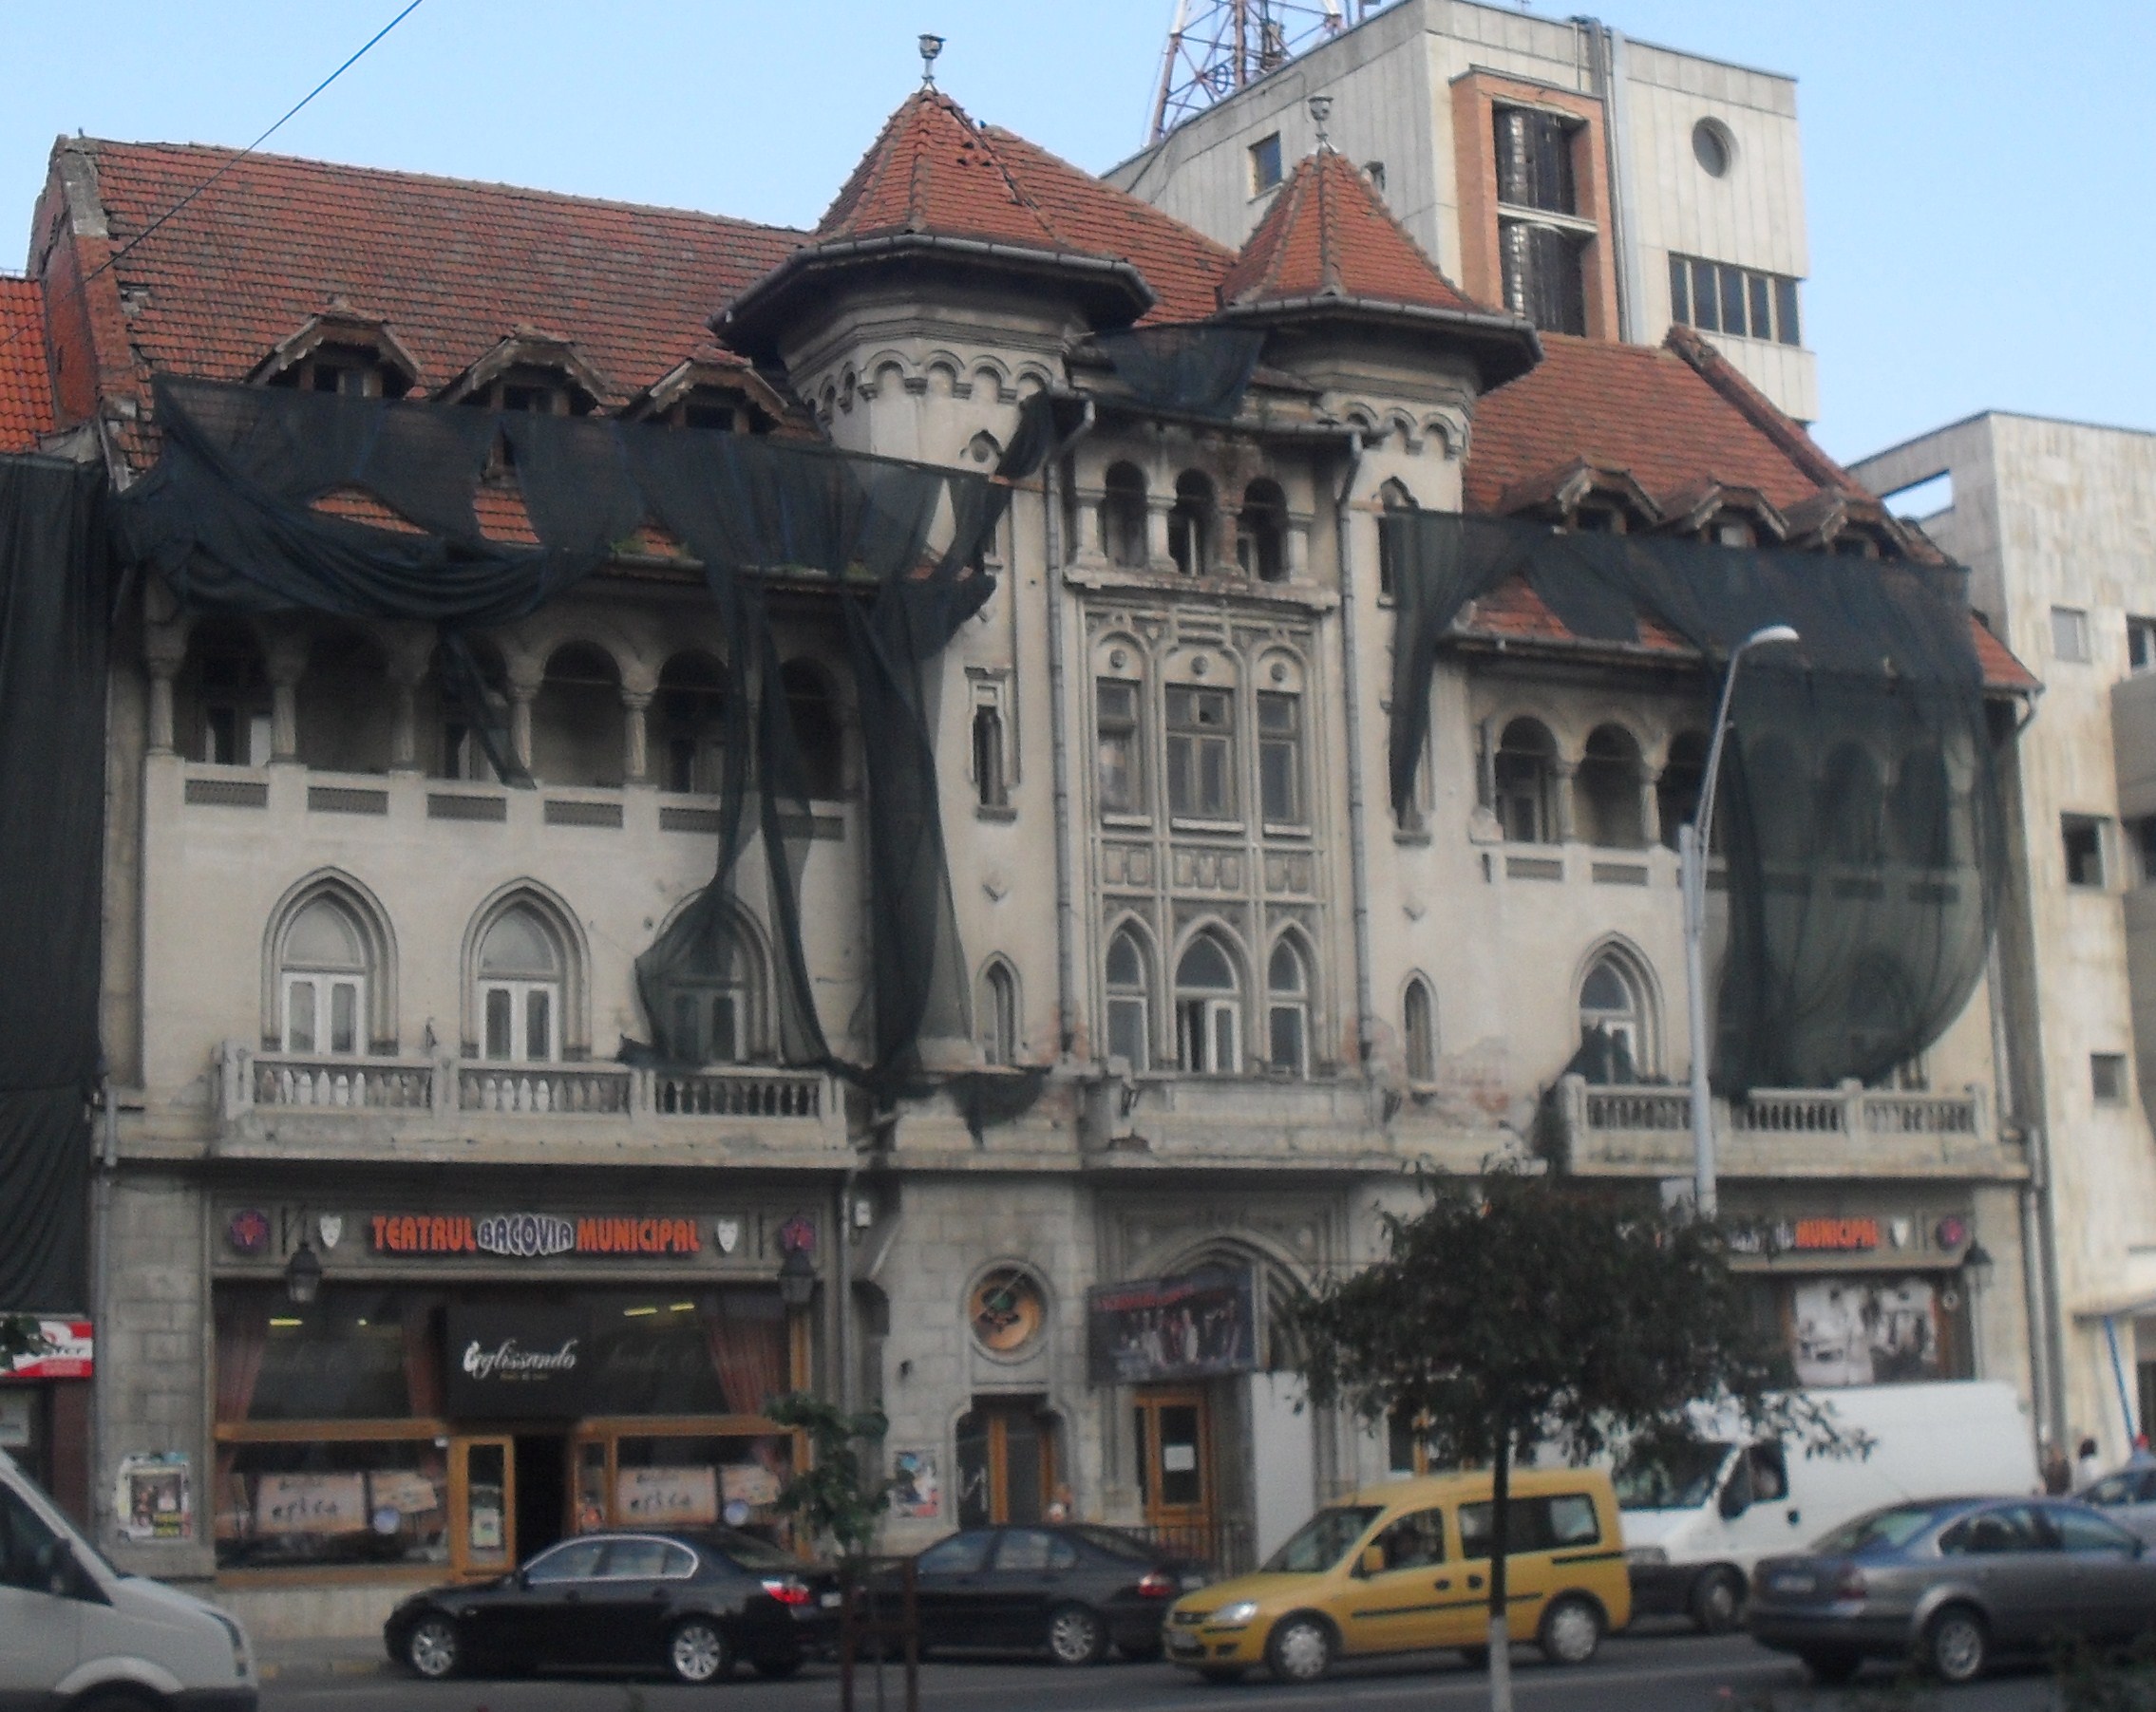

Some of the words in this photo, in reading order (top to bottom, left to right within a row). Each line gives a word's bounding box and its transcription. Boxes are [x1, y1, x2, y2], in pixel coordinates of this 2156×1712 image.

[371, 1215, 476, 1251] TEATRUL
[477, 1213, 574, 1256] BACOVIA
[576, 1217, 701, 1252] MUNICIPAL
[1795, 1218, 1878, 1249] MUNICIPAL
